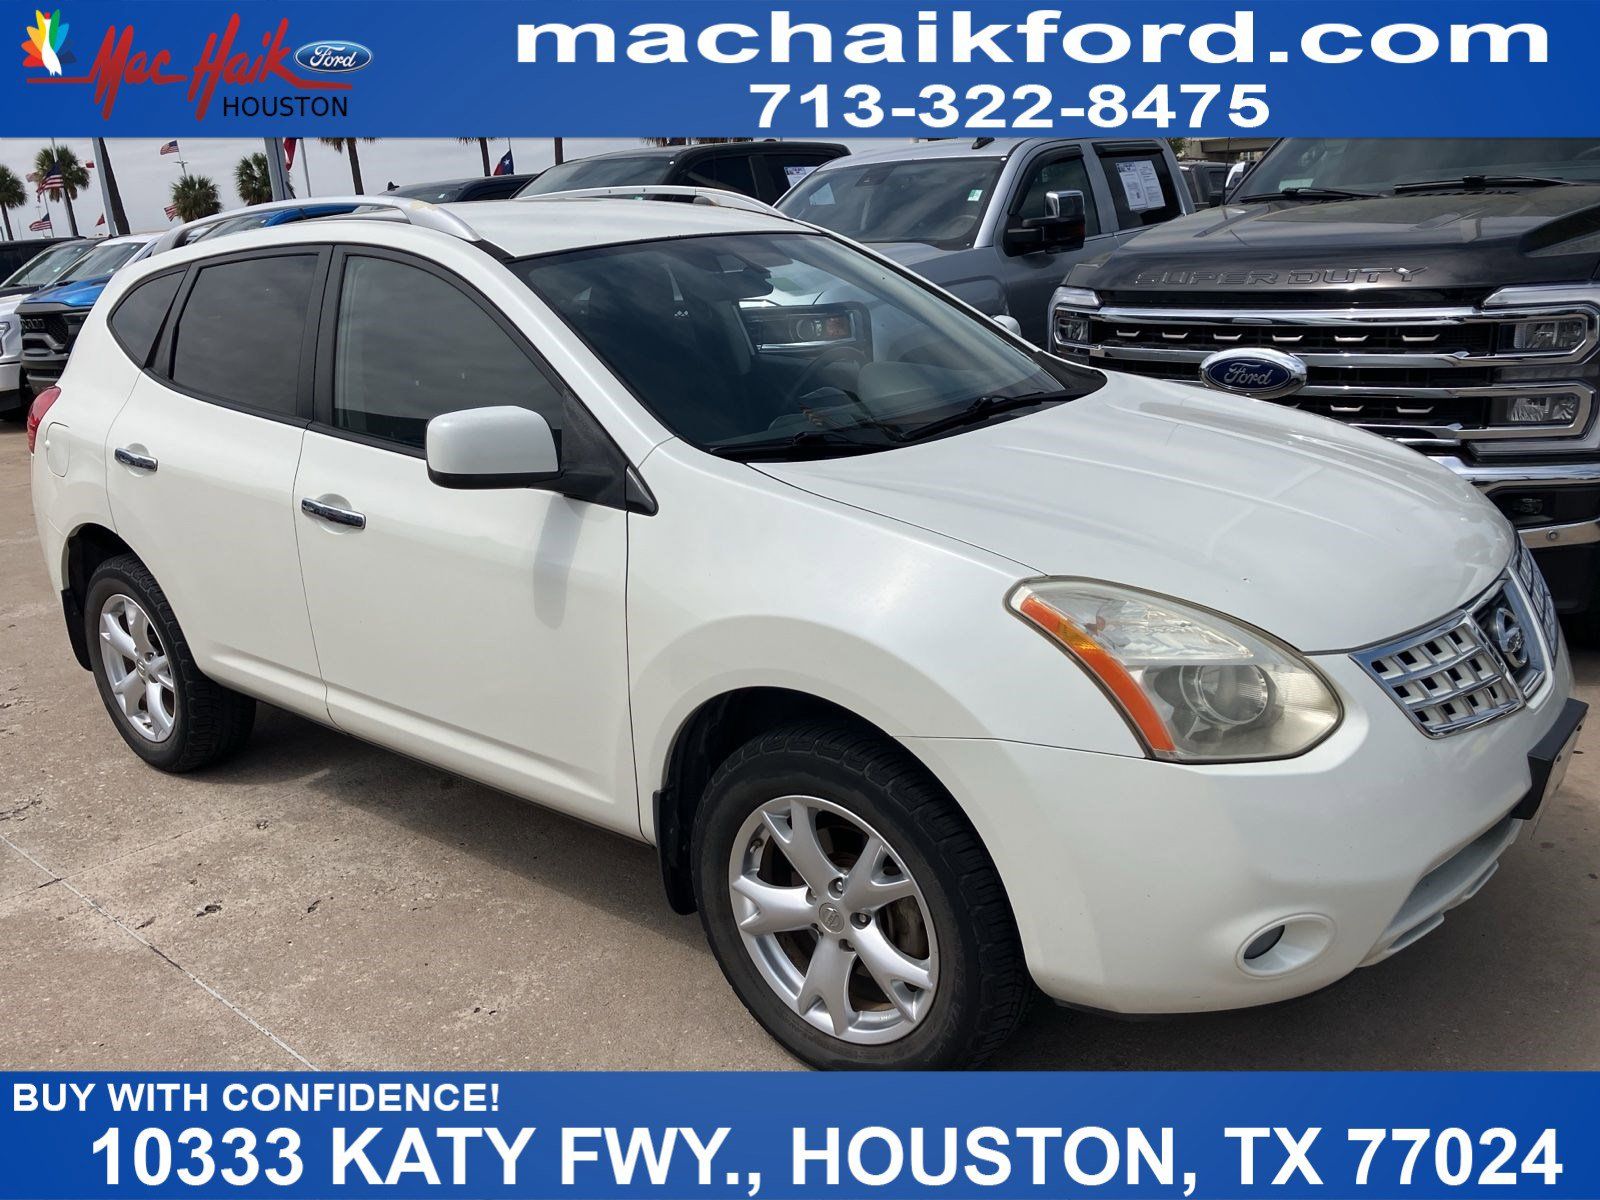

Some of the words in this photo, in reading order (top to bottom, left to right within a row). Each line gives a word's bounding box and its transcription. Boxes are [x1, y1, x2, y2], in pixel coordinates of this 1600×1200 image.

[1135, 270, 1279, 285] SUPER
[1287, 266, 1428, 285] DUTY
[1223, 362, 1272, 386] Ford
